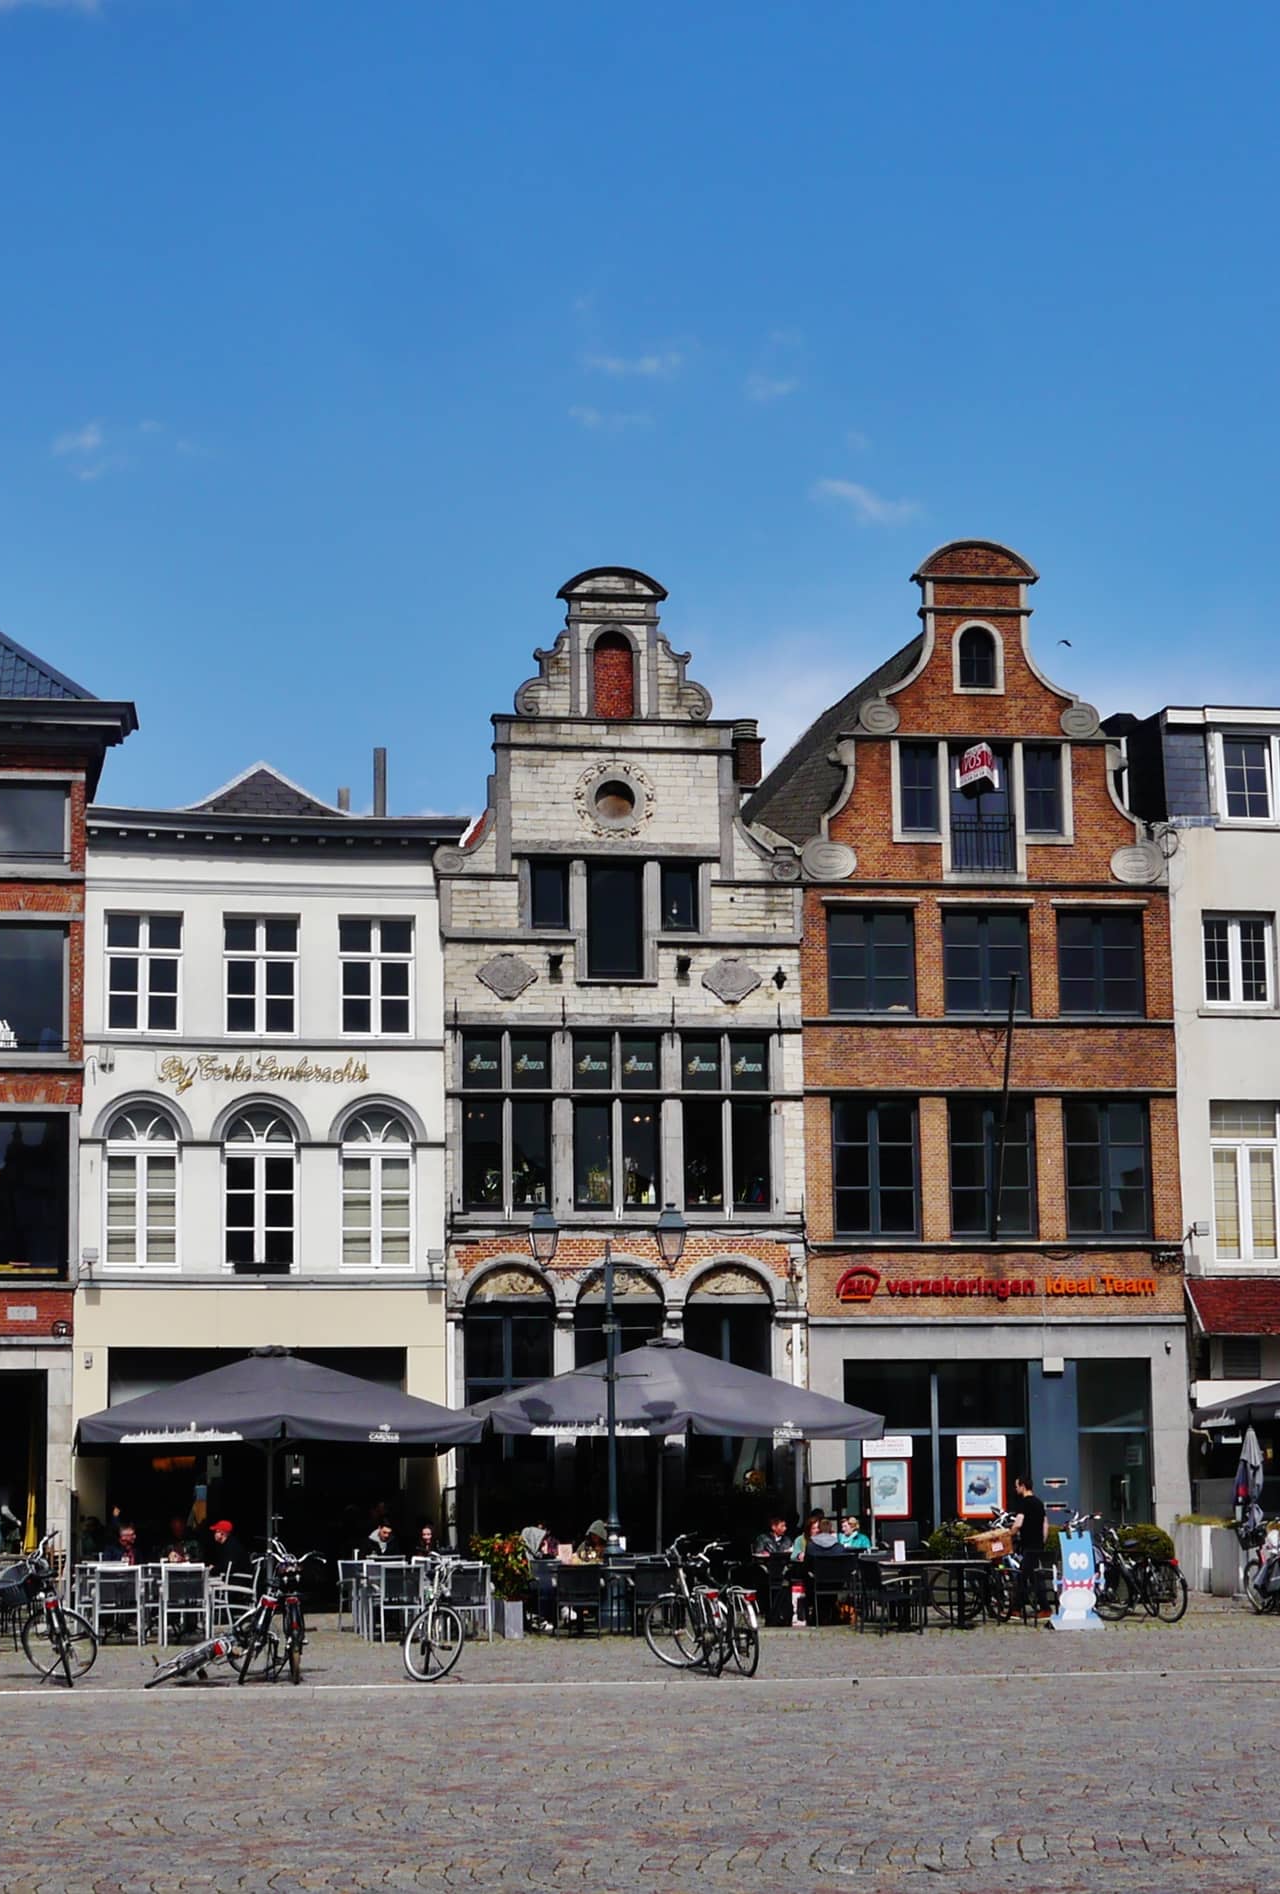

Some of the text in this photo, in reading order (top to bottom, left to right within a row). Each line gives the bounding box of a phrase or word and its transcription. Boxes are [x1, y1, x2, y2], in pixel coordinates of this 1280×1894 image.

[885, 1276, 1036, 1298] verzekeringen
[1045, 1276, 1094, 1294] Ideal
[1100, 1275, 1156, 1294] Team
